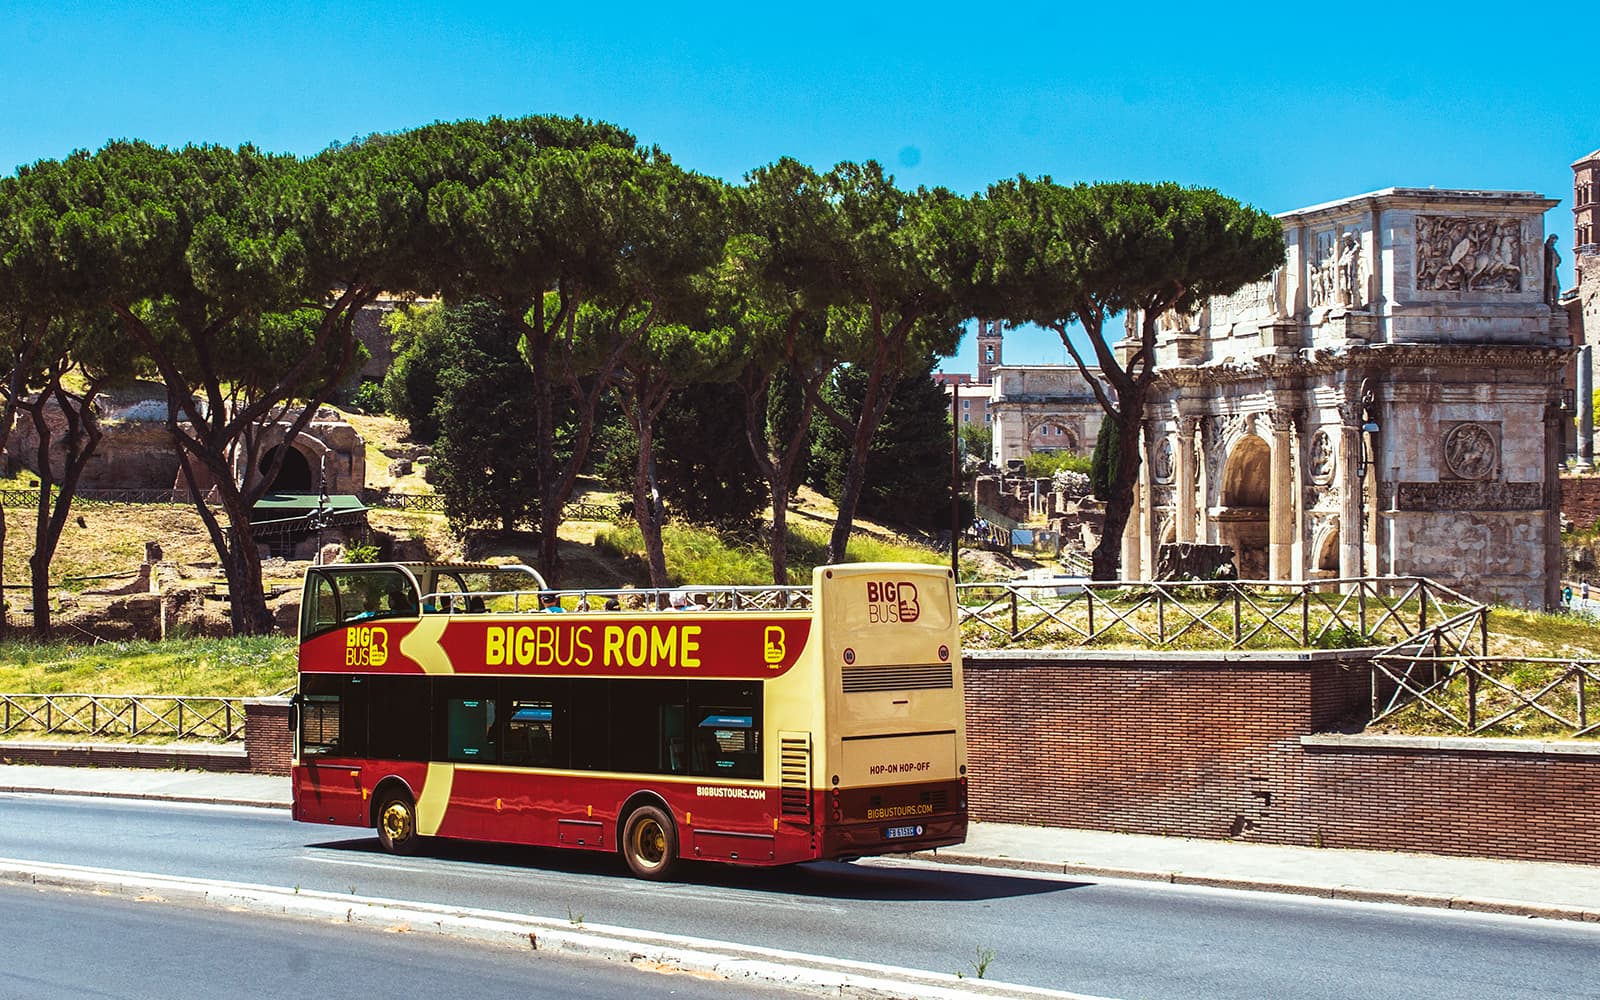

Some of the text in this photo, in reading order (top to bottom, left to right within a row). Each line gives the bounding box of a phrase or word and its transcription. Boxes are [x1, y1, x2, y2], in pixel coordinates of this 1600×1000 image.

[866, 581, 897, 603] BIG
[868, 604, 899, 624] BUS
[346, 626, 370, 648] BIG
[603, 625, 702, 668] ROME
[345, 647, 370, 667] BUS
[869, 761, 931, 775] HOP-ON HOP-OFF
[696, 785, 766, 801] BIGBUSTOURS.COM
[867, 803, 933, 820] BIGBUSTOURS.COM
